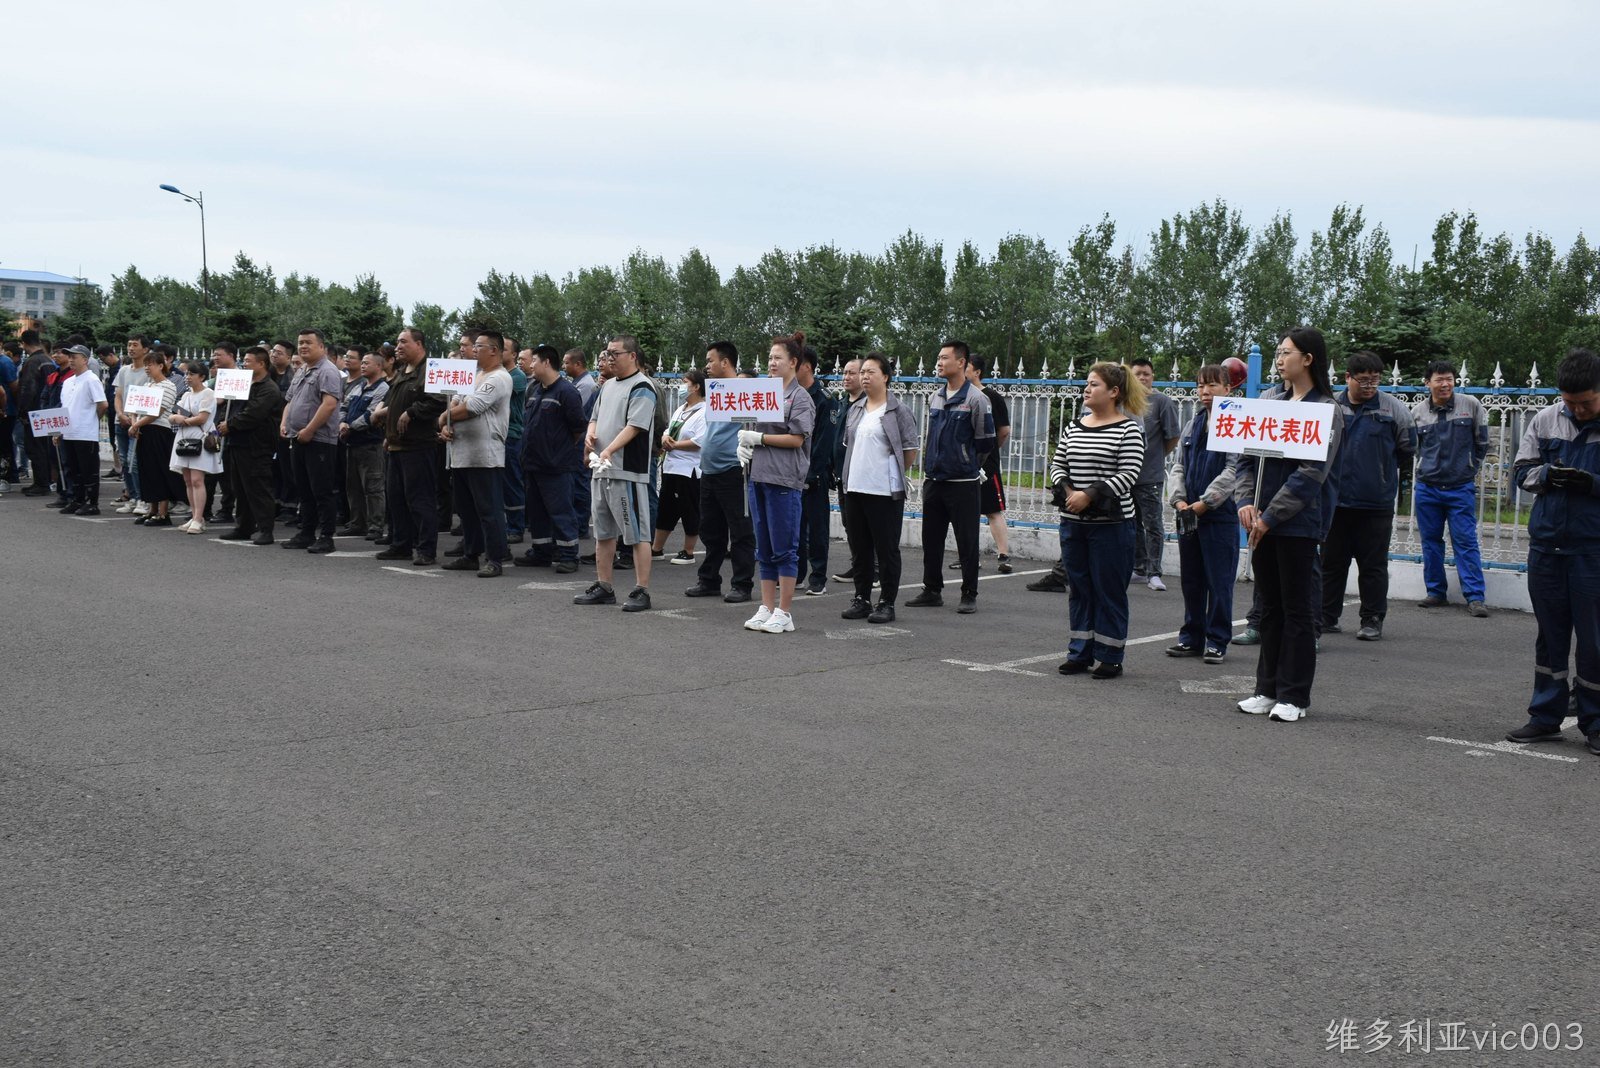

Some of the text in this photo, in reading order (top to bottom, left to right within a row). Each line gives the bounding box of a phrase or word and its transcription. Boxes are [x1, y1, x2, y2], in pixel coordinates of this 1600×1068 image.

[217, 378, 249, 392] 生产代表队5
[428, 369, 473, 386] 生产代表队6
[710, 392, 779, 411] 机关代表队
[33, 416, 69, 430] 生产代表队3
[1215, 414, 1322, 445] 技术代表队
